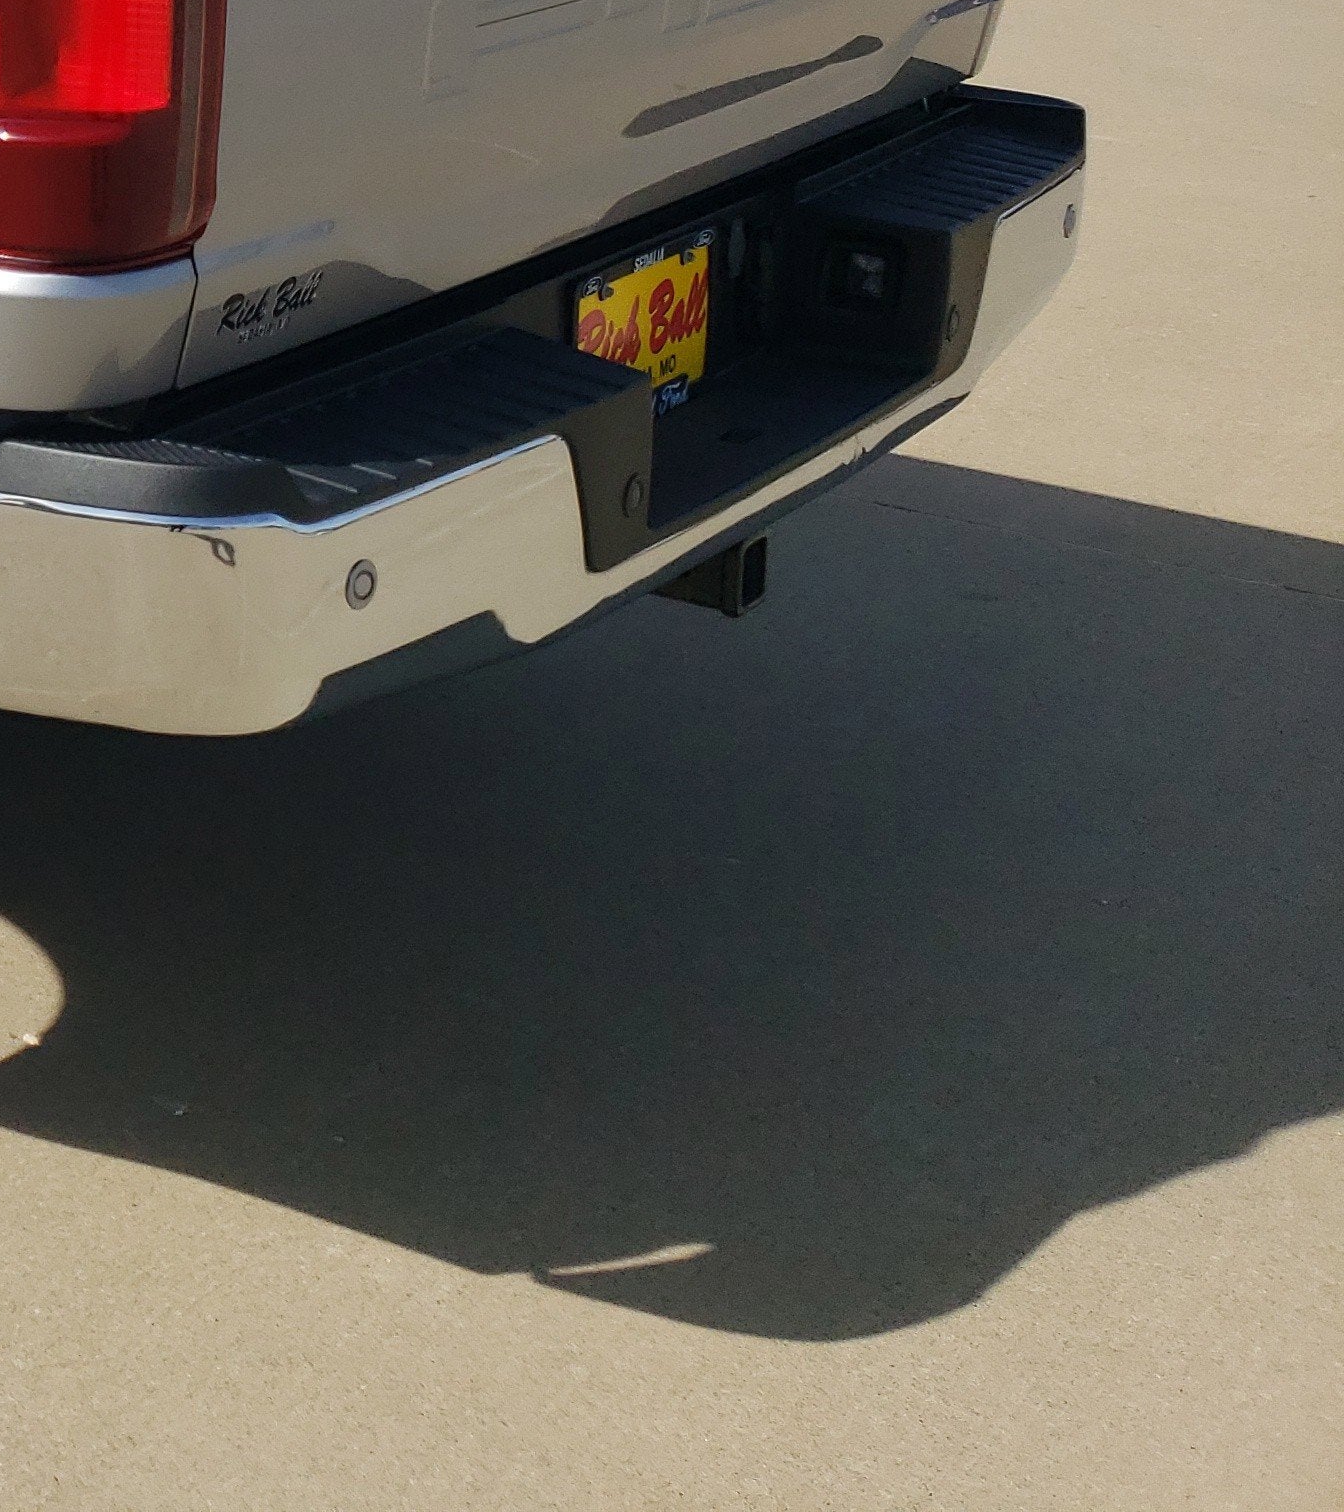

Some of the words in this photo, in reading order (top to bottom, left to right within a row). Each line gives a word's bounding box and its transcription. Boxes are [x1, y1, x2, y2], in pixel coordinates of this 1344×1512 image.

[215, 287, 270, 336] Rick
[273, 270, 323, 318] Ball
[648, 267, 709, 354] Ball
